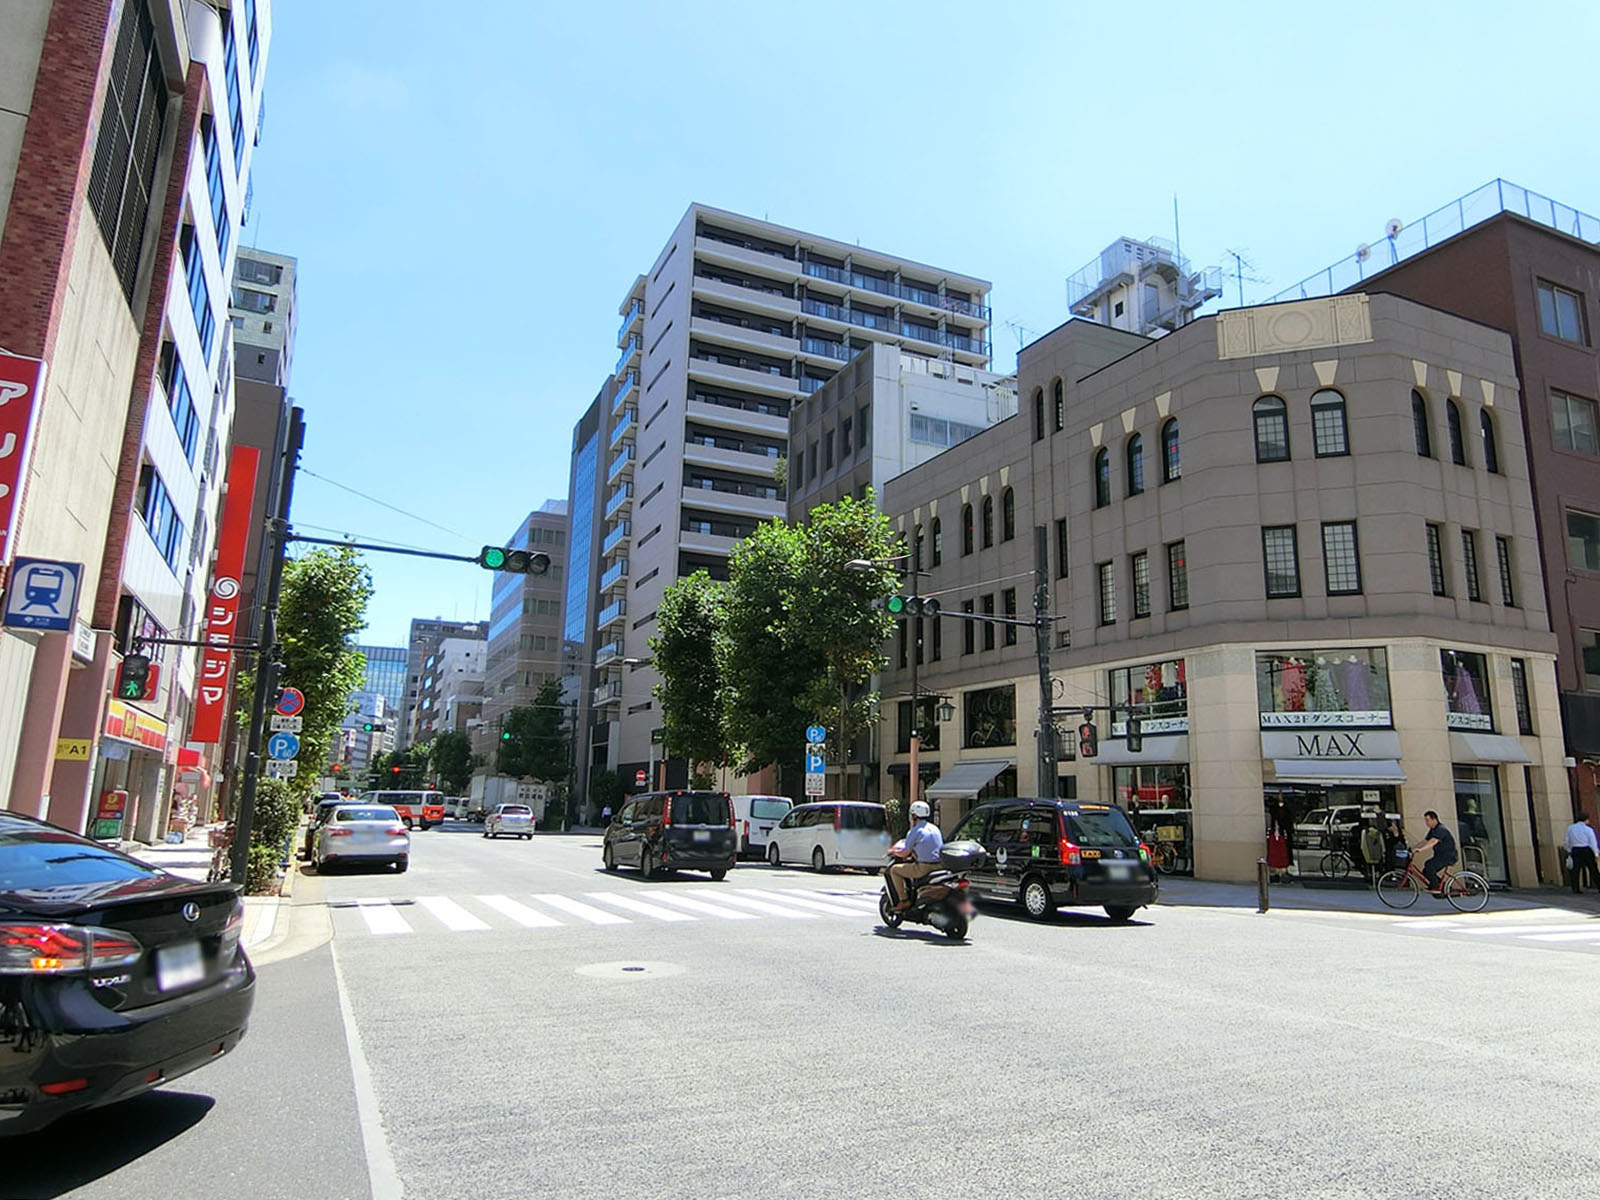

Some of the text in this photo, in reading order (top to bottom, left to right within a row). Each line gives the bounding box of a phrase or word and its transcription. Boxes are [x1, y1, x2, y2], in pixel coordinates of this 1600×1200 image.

[202, 606, 233, 705] シモジマ
[1262, 713, 1389, 724] MAX2Fダンスコーナー
[69, 745, 87, 755] A1
[275, 739, 288, 757] P
[1296, 733, 1366, 757] MAX
[811, 756, 822, 771] P
